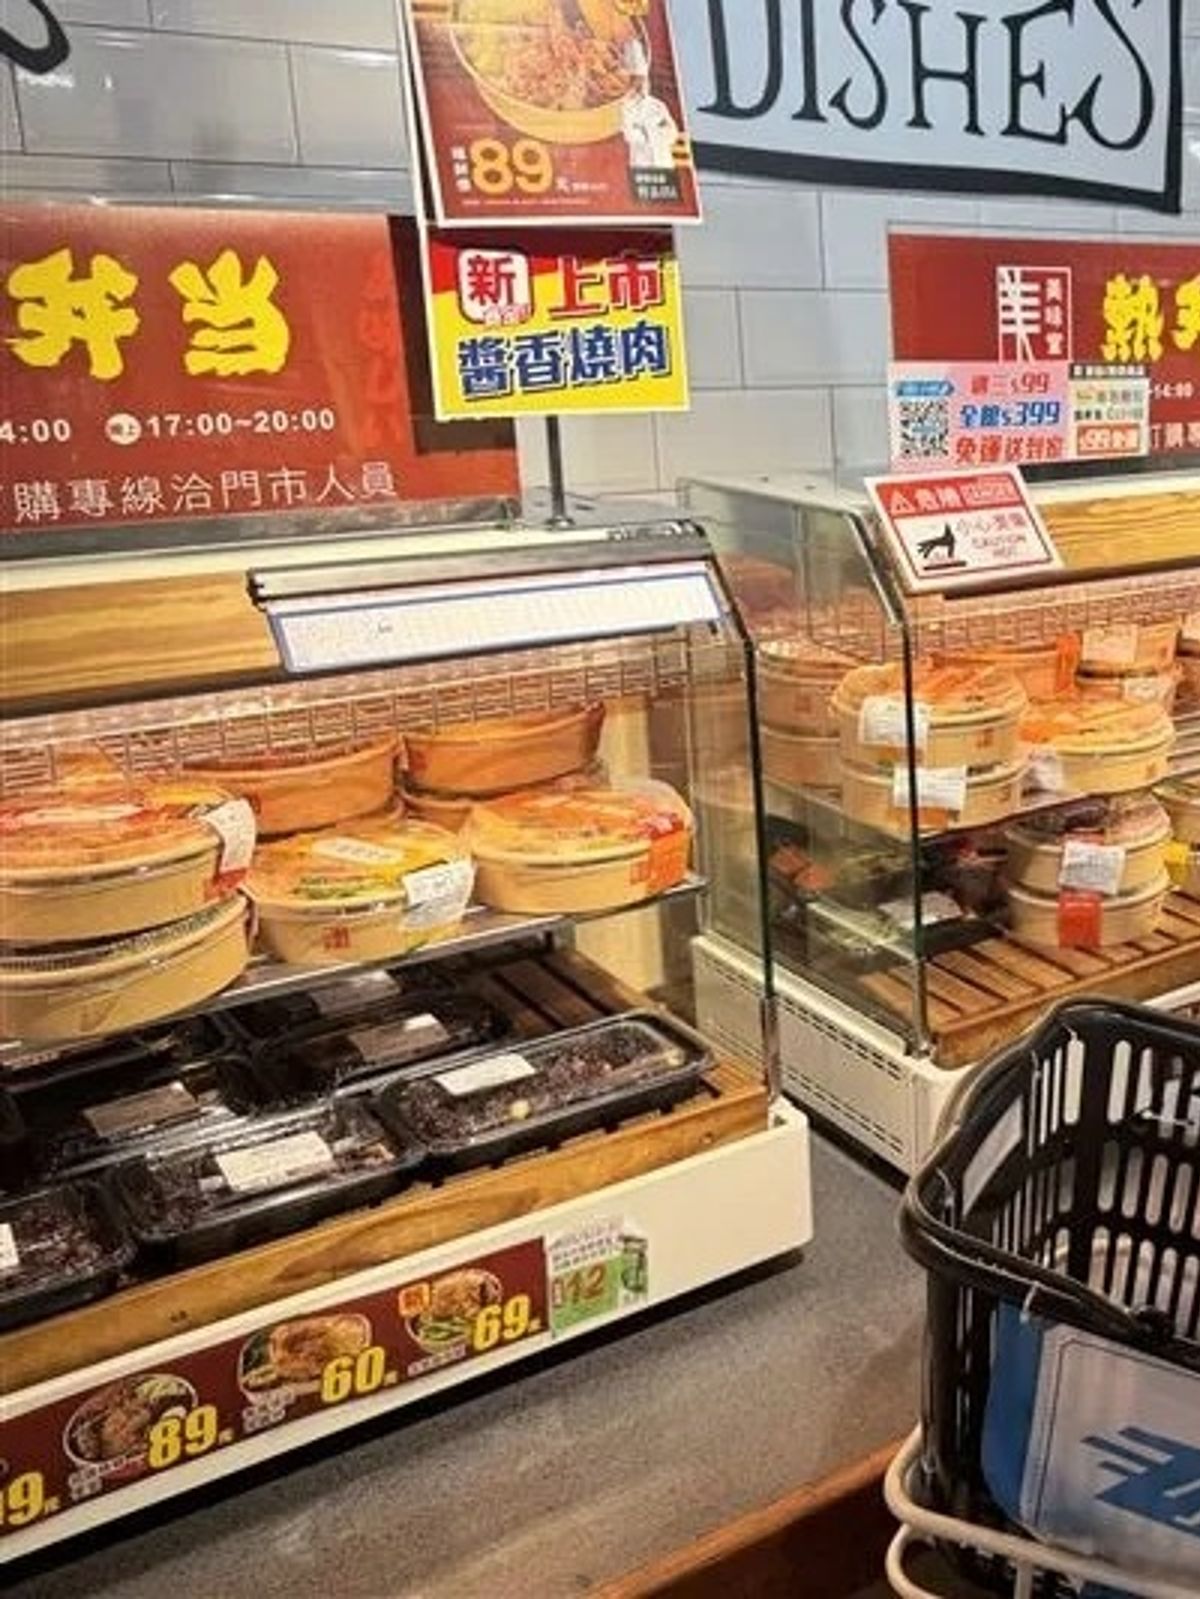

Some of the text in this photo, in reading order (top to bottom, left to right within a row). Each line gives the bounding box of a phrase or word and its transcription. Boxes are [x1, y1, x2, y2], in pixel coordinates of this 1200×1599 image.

[698, 0, 1154, 151] DISHES
[469, 137, 554, 195] 89
[5, 248, 291, 380] 弁当
[467, 252, 665, 318] 新 上市
[458, 320, 668, 398] 醬香燒肉
[147, 407, 336, 438] 17:00~20:00
[0, 461, 398, 523] 購專線洽門市人員
[473, 1294, 531, 1351] 69
[321, 1347, 385, 1402] 60
[149, 1404, 217, 1468] 89
[0, 1472, 43, 1525] 9
